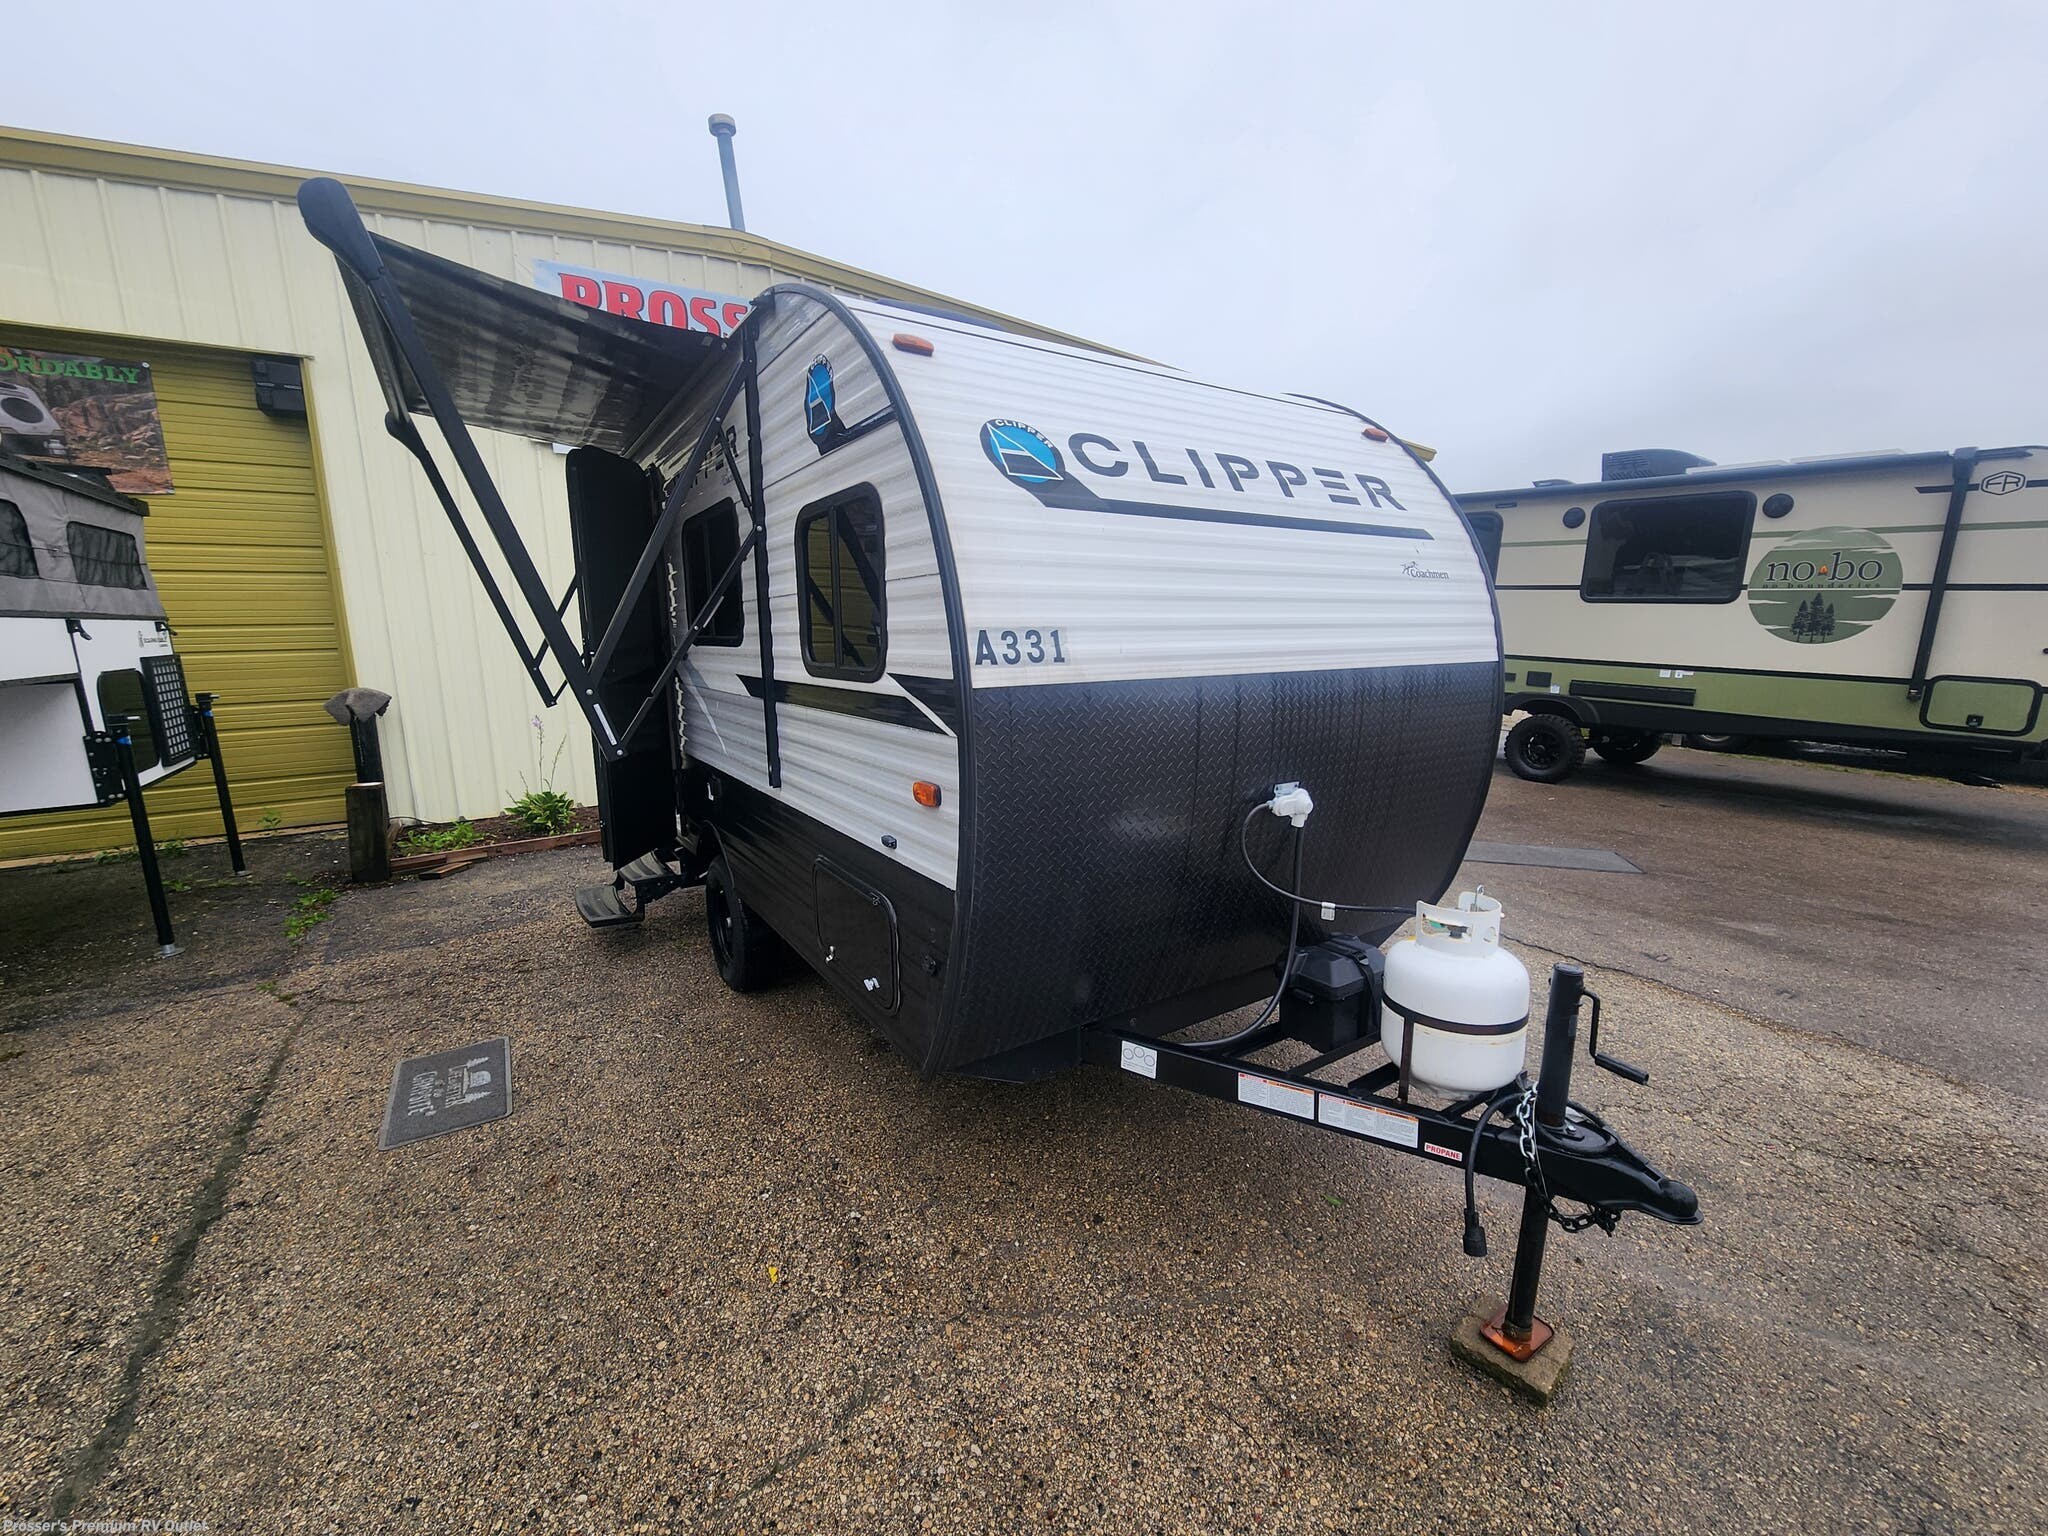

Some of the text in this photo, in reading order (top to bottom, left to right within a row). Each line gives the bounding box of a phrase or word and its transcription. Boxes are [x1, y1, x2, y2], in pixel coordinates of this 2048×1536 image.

[995, 419, 1054, 449] CLIPPER
[1068, 433, 1407, 511] CLIPPER
[975, 629, 1065, 666] A331
[1425, 1144, 1461, 1160] PROPANE
